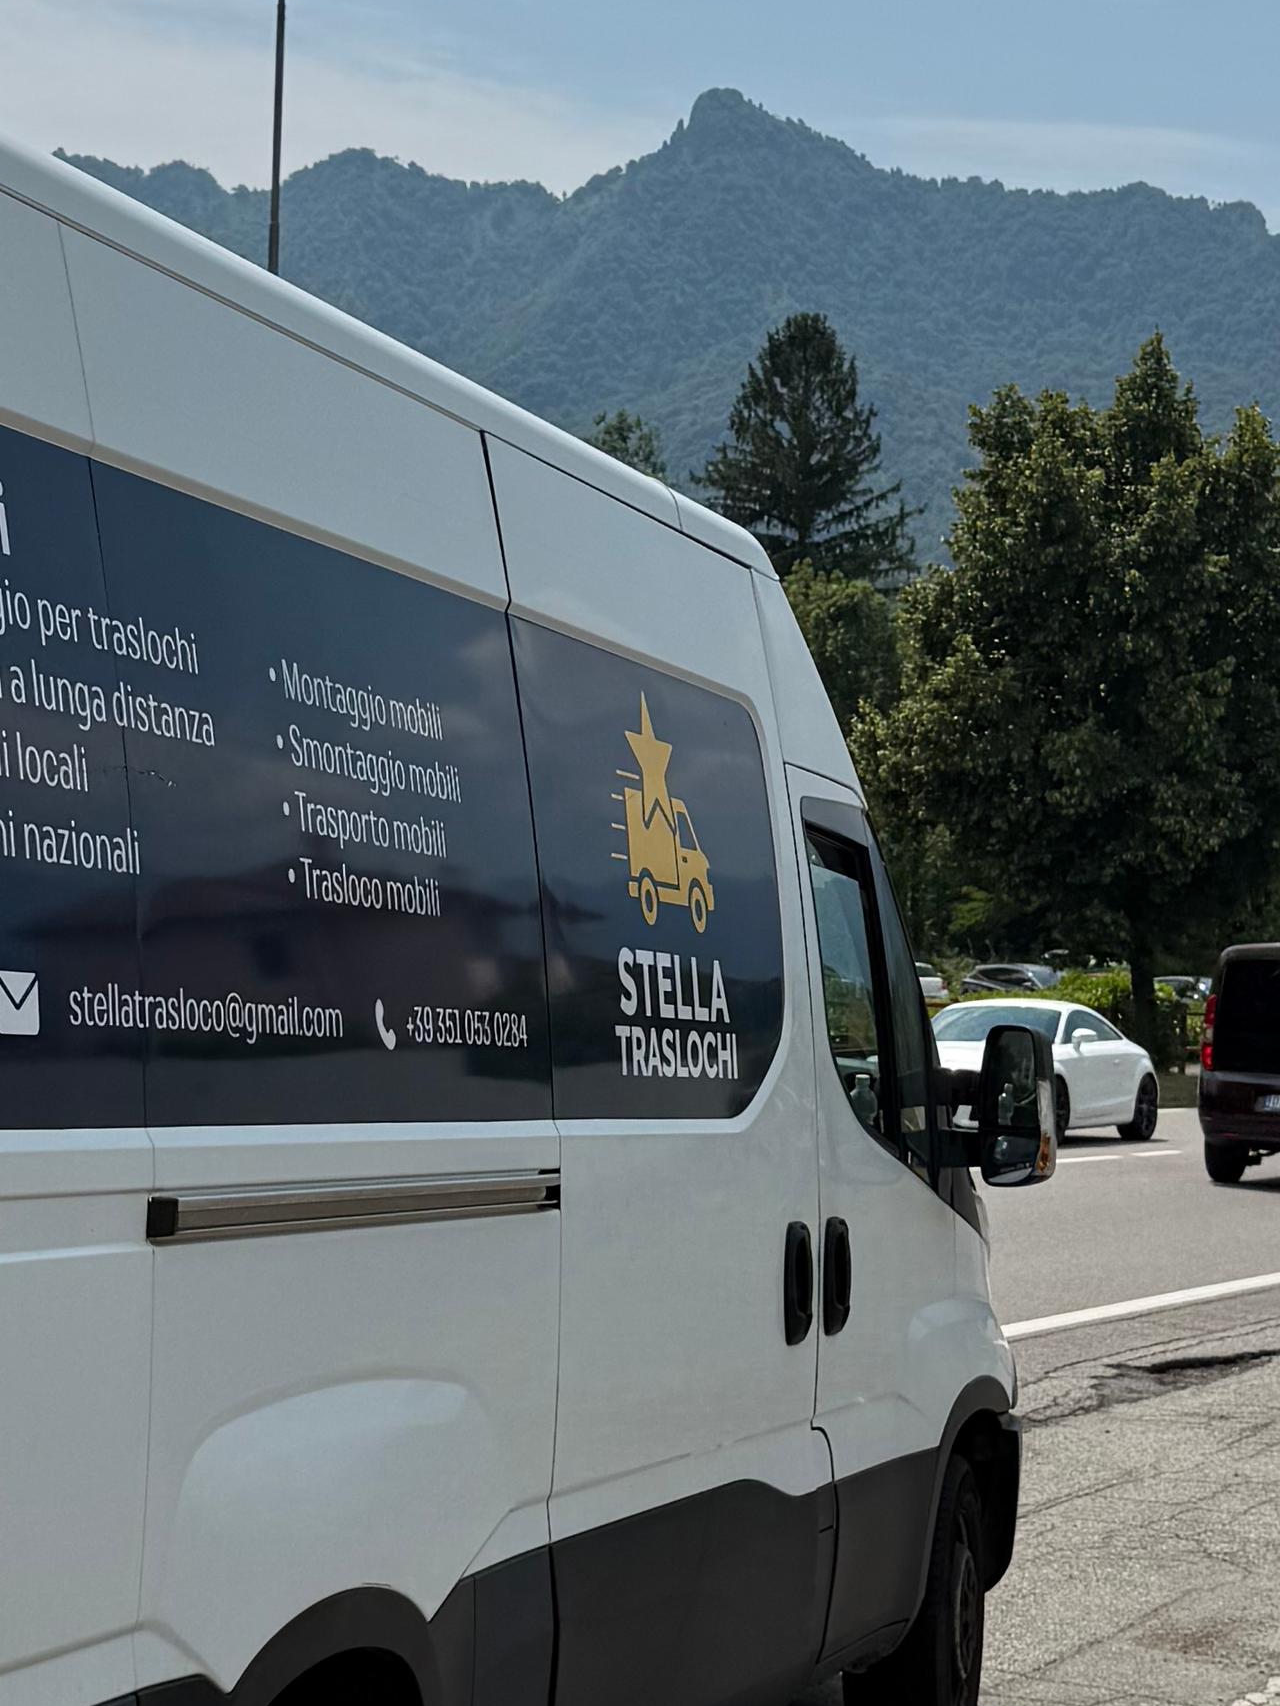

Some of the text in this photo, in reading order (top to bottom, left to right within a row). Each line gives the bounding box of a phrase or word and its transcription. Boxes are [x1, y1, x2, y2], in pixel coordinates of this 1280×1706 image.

[37, 599, 82, 646] per
[87, 607, 199, 675] traslochi
[9, 666, 27, 704] a
[30, 658, 107, 731] lunga
[112, 681, 215, 747] distanza
[281, 658, 443, 741] Montaggio mobili
[16, 731, 89, 792] locali
[289, 724, 462, 804] Smontaggio mobili
[23, 819, 140, 875] nazionali
[294, 790, 447, 858] Trasporto mobili
[299, 857, 441, 917] Trasloco mobili
[69, 982, 343, 1045] stellatrasloco@gmail.com
[617, 946, 731, 1024] STELLA
[406, 1006, 528, 1048] +39 351 053 0284
[614, 1025, 739, 1080] TRASLOCHI
